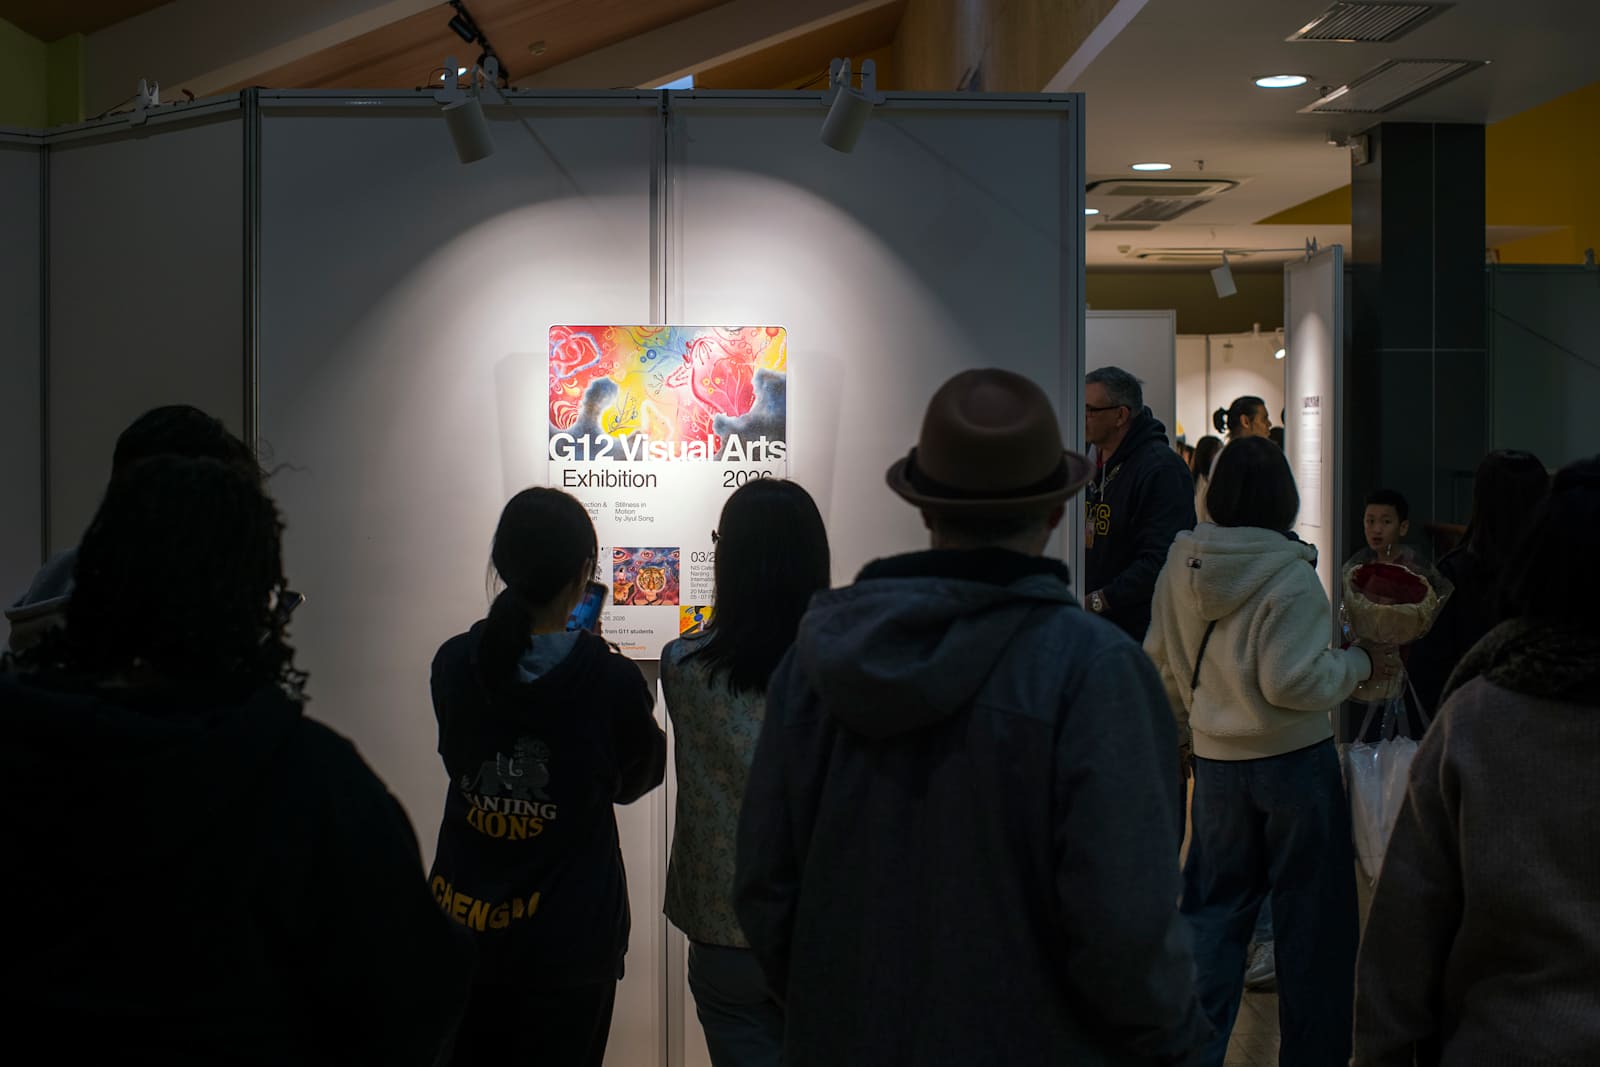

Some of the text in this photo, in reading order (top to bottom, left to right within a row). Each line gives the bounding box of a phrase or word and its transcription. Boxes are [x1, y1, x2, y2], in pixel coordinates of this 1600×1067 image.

[548, 433, 787, 462] G12 Visual Arts
[563, 469, 657, 488] Exhibition
